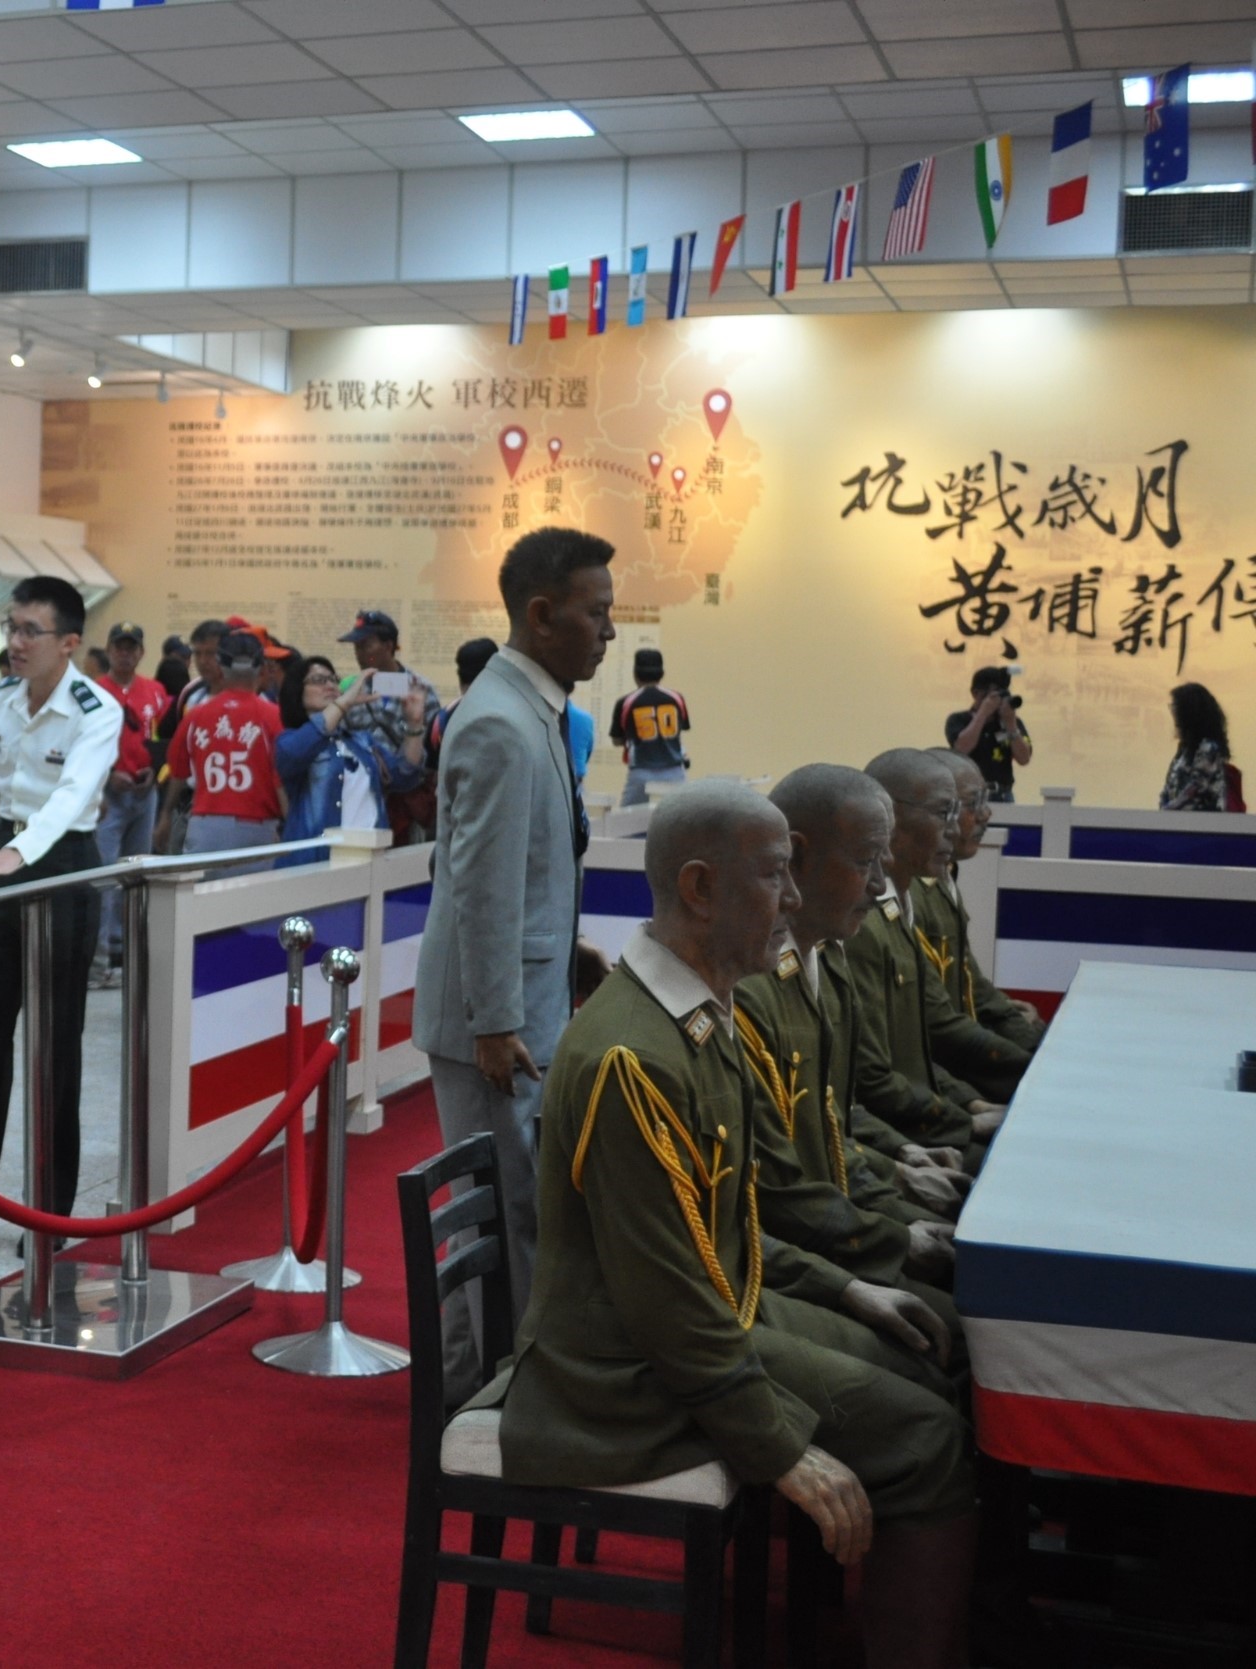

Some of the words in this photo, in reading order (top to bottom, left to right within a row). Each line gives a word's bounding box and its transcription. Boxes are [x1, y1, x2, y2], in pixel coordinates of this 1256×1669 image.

[303, 379, 435, 412] 抗戰烽火
[451, 376, 590, 410] 軍校西遷
[705, 457, 724, 495] 南京
[502, 493, 520, 529] 成都
[668, 506, 687, 545] 九江
[633, 704, 679, 741] 50
[204, 751, 253, 793] 65
